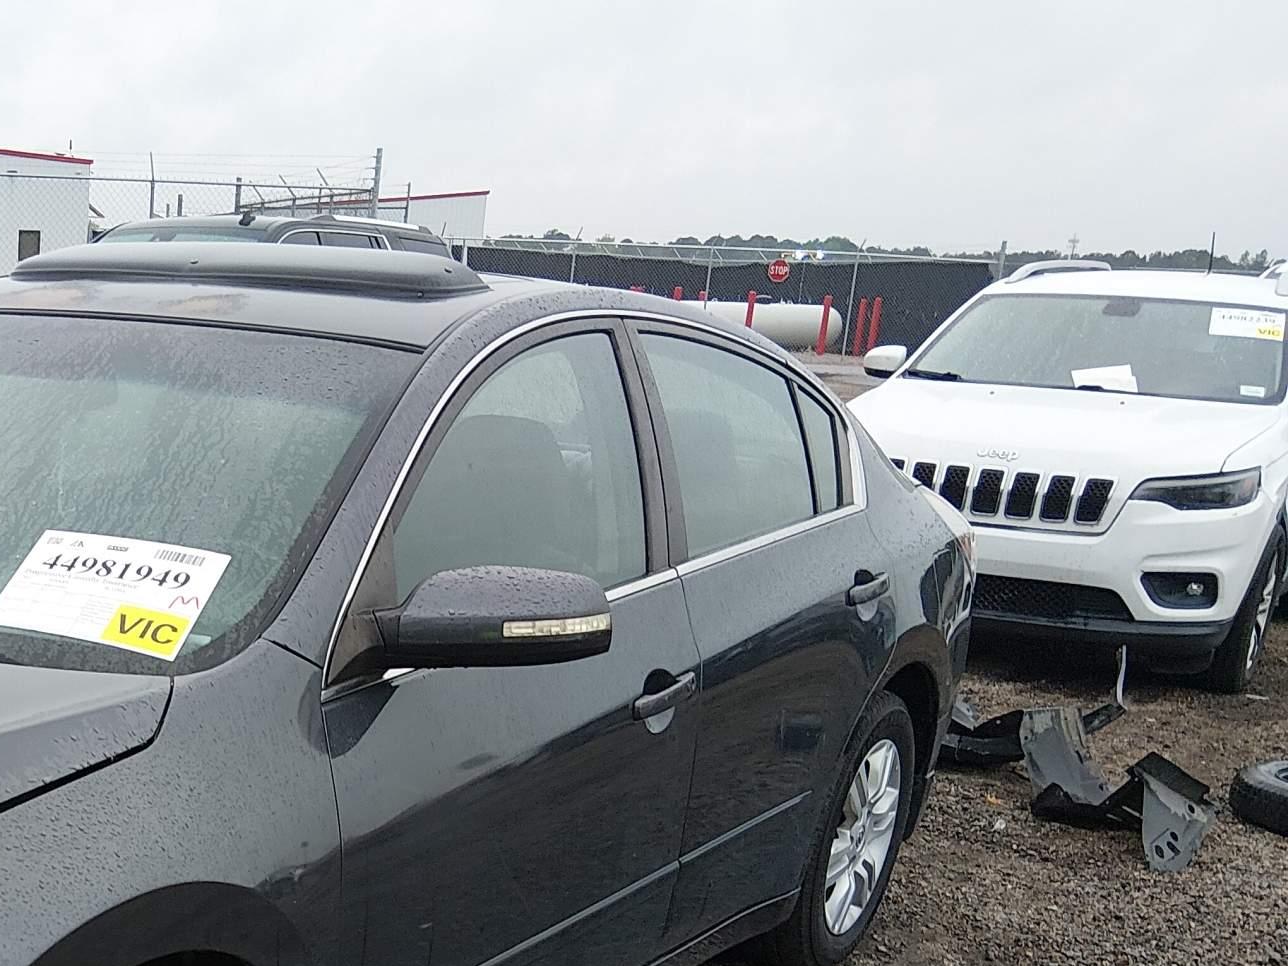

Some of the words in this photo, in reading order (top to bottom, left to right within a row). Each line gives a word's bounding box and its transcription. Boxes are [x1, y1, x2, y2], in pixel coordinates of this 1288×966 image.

[770, 265, 788, 275] STOP
[42, 553, 191, 589] 44981949
[119, 612, 179, 645] VIC
